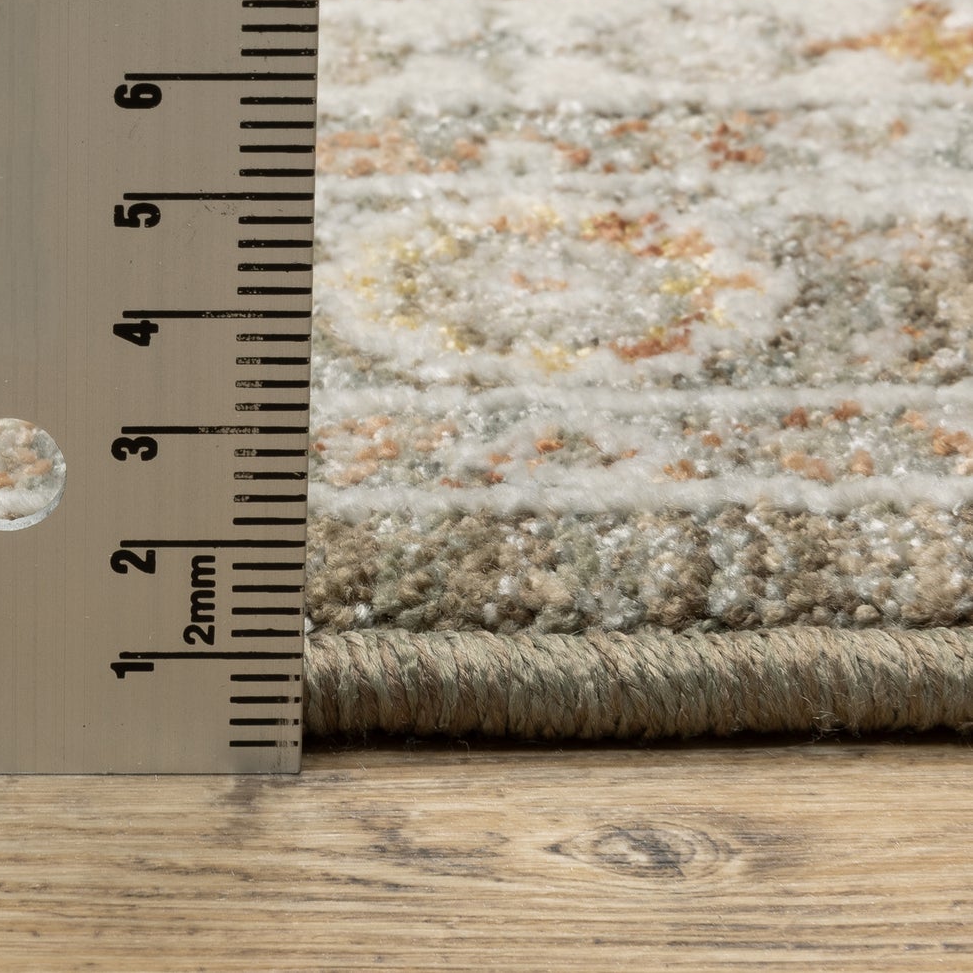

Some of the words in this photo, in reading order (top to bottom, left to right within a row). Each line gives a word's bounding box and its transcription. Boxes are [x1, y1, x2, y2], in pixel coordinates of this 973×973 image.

[113, 82, 163, 110] 6
[113, 202, 162, 229] 5
[112, 319, 159, 347] 4
[110, 435, 159, 462] 3
[109, 549, 157, 575] 2
[182, 554, 216, 646] 2mm
[109, 661, 155, 680] 1
